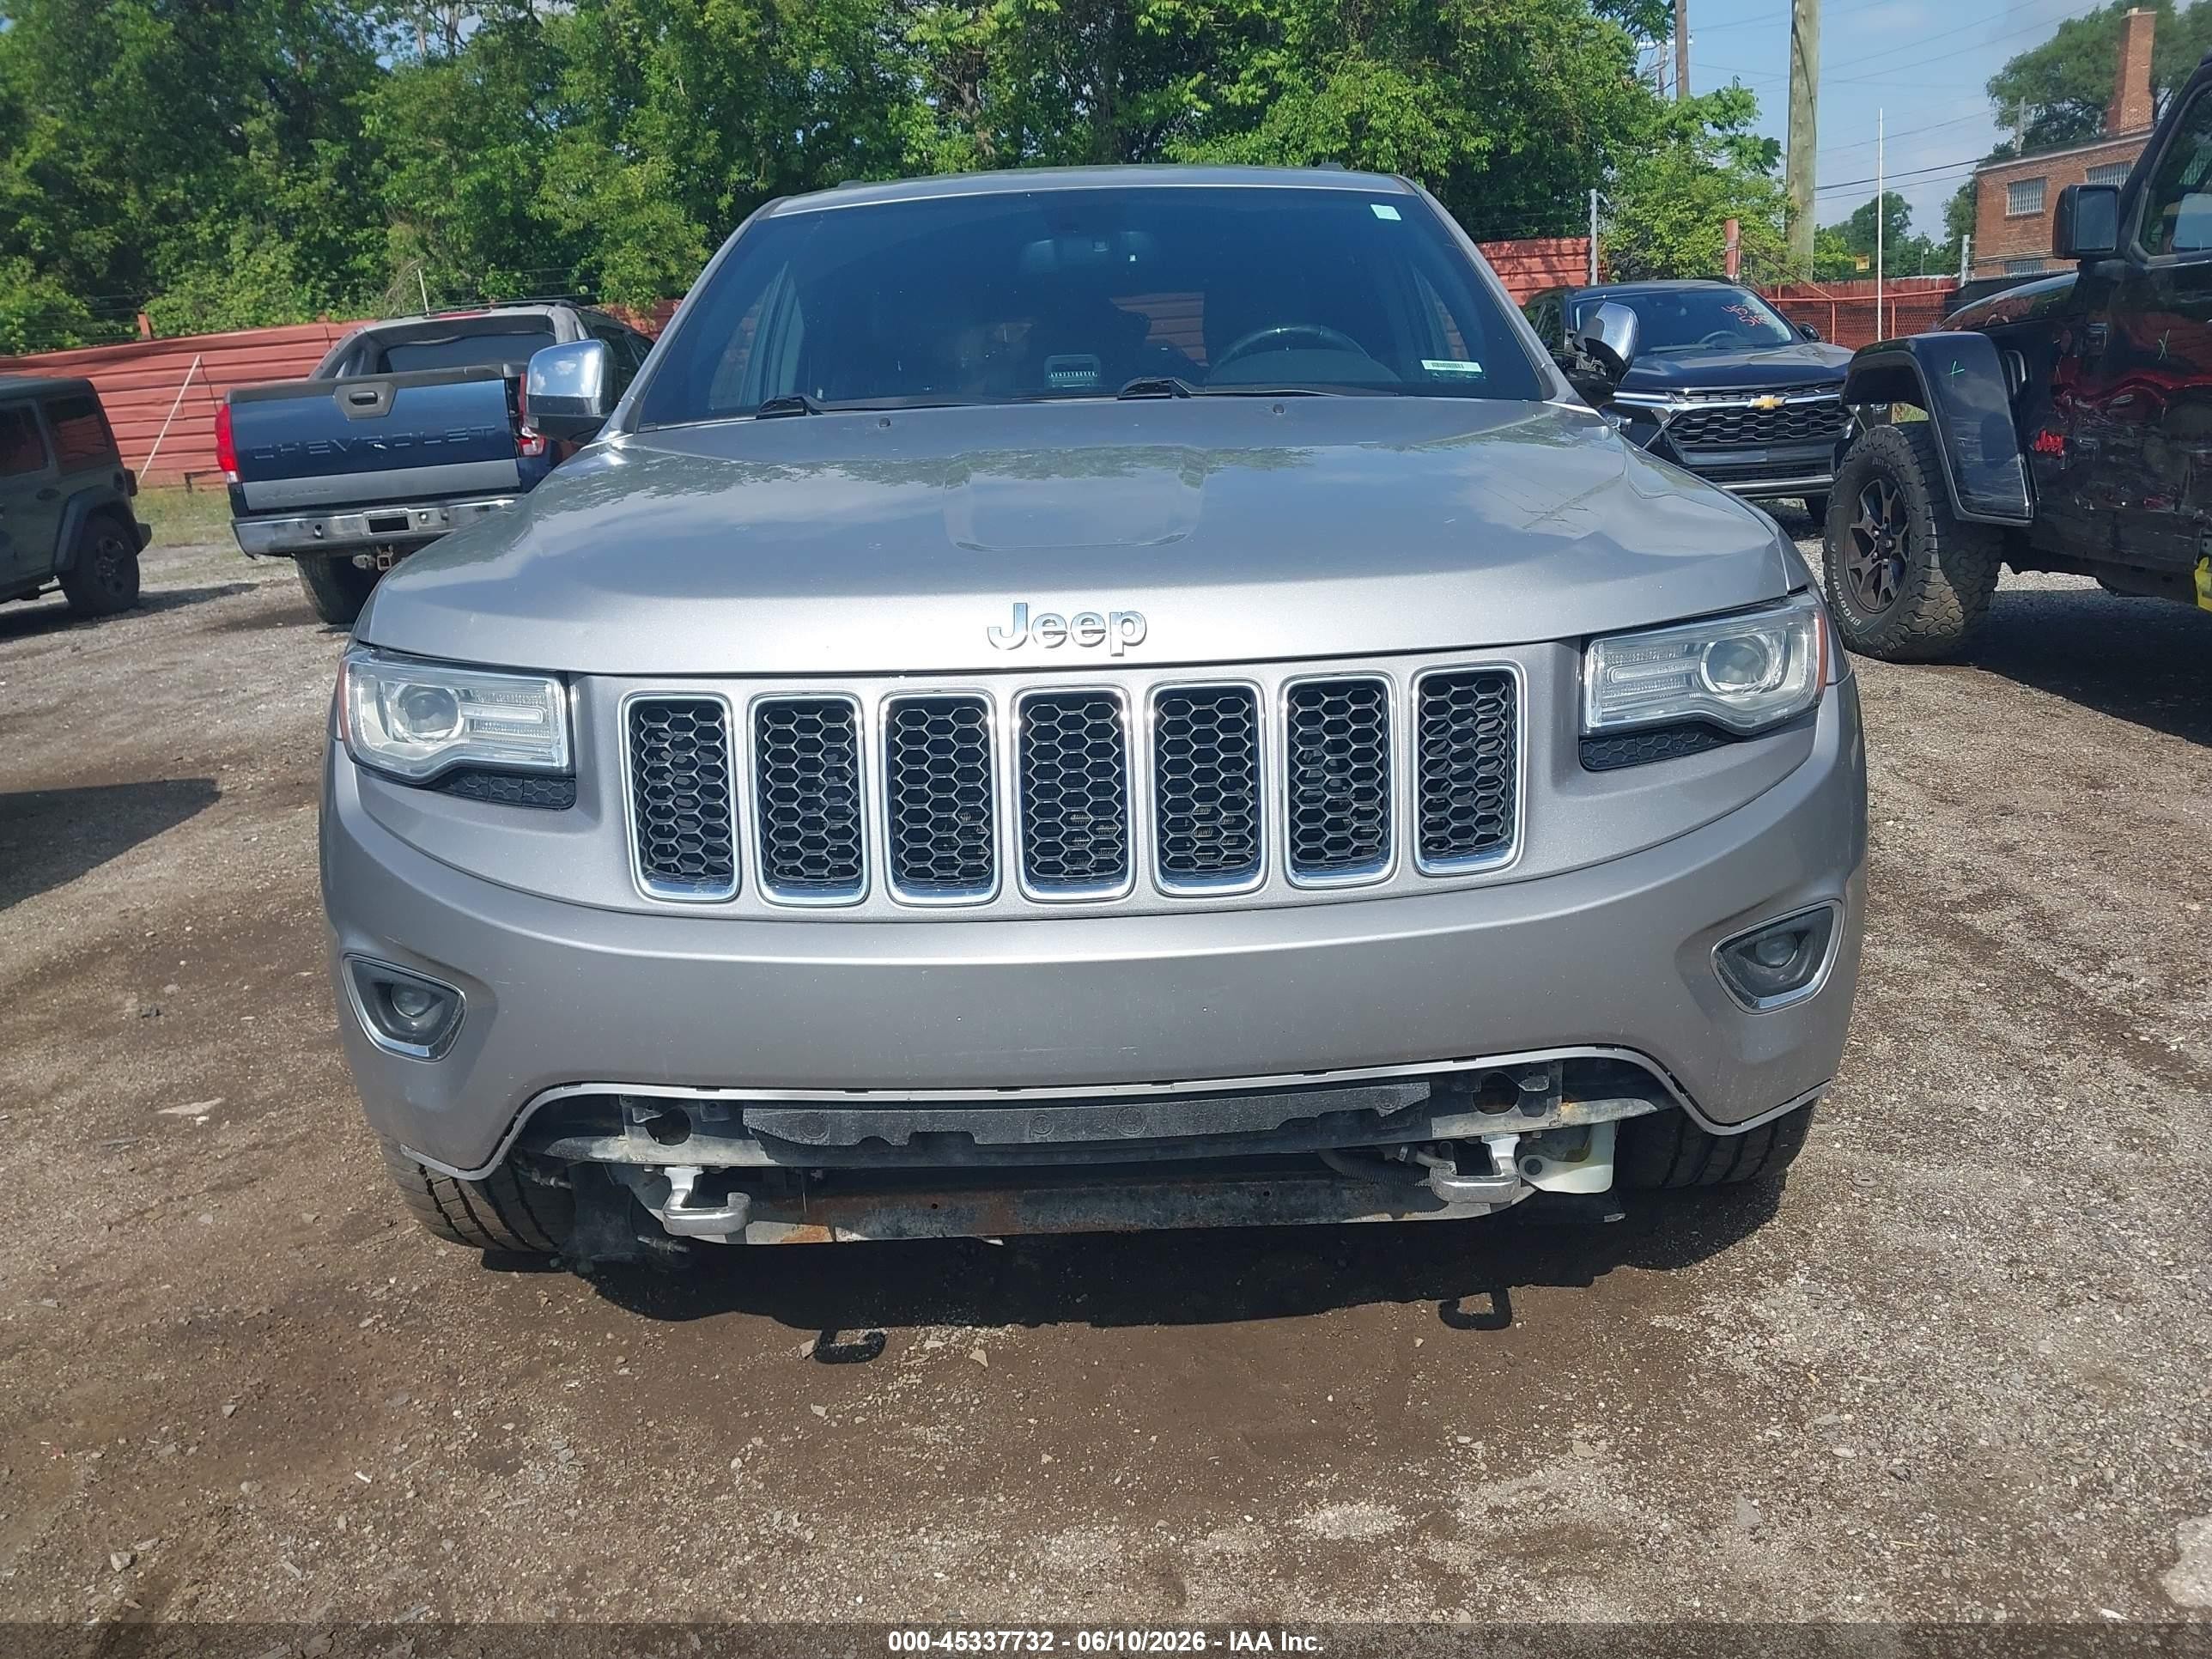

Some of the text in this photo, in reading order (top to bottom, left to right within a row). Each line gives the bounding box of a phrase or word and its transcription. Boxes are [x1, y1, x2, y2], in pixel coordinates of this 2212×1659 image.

[252, 426, 495, 459] CHEVROLET
[2034, 429, 2064, 457] Jeep
[988, 603, 1147, 657] Jeep
